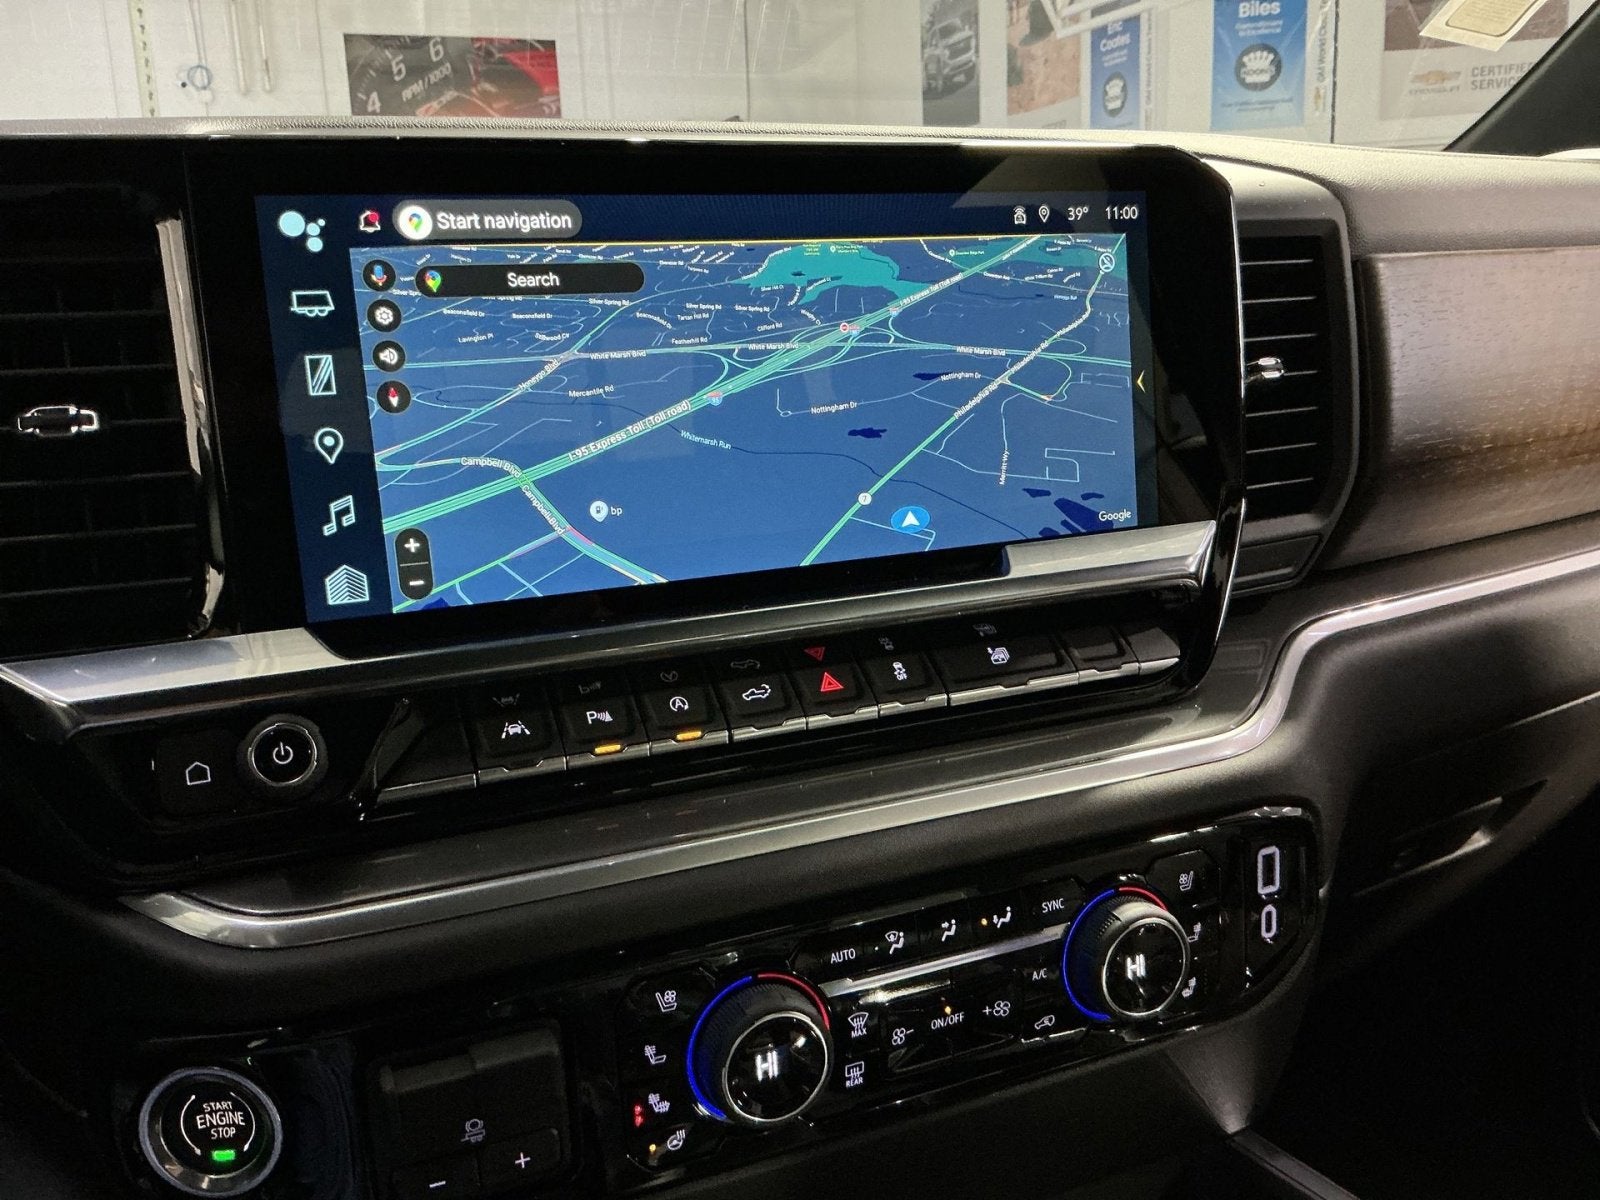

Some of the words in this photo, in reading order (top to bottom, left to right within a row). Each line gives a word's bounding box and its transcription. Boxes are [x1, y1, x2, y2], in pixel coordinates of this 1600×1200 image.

[1238, 0, 1281, 18] Biles
[429, 37, 444, 63] 6
[391, 54, 407, 82] 5
[1470, 76, 1522, 91] SERVIC
[366, 91, 382, 114] 4
[1105, 206, 1139, 220] 11:00
[437, 212, 481, 229] Start
[484, 211, 572, 233] navigation
[507, 272, 560, 288] Search
[910, 289, 929, 302] Express
[757, 323, 774, 331] Clifford
[458, 335, 487, 343] Lavington
[590, 352, 608, 360] White
[610, 351, 630, 359] Marsh
[631, 350, 646, 358] Blvd
[993, 348, 1006, 356] Blvd
[1010, 347, 1041, 374] Philadelphia
[1040, 340, 1049, 350] Rd
[519, 370, 545, 390] Honeygo
[544, 359, 559, 373] Blvd
[941, 372, 974, 382] Nottingham
[569, 387, 603, 397] Mercantile
[604, 385, 615, 393] Rd
[811, 403, 848, 414] Nottingham
[954, 387, 990, 419] Philadelphia
[989, 383, 998, 392] Rd
[568, 447, 589, 461] I-95
[590, 431, 627, 452] Express
[627, 422, 645, 435] Toll
[645, 411, 666, 429] (Toll
[667, 399, 692, 417] road)
[681, 429, 718, 447] Whitemarsh
[719, 440, 732, 450] Run
[461, 457, 503, 469] Campbell
[503, 464, 522, 478] Blvd
[999, 458, 1008, 486] Merritt
[521, 484, 551, 521] Campbell
[548, 517, 565, 535] Blvd
[611, 505, 623, 516] bp
[1098, 509, 1132, 522] Google
[1042, 899, 1065, 914] SYNC
[831, 948, 856, 965] AUTO
[1032, 968, 1048, 981] A/C
[1126, 953, 1147, 981] HI
[931, 1012, 965, 1030] ON/OFF
[851, 1027, 867, 1038] MAX
[755, 1050, 779, 1082] HI
[846, 1077, 863, 1088] REAR
[203, 1101, 233, 1112] START
[196, 1111, 245, 1129] ENGINE
[211, 1127, 236, 1140] STOP
